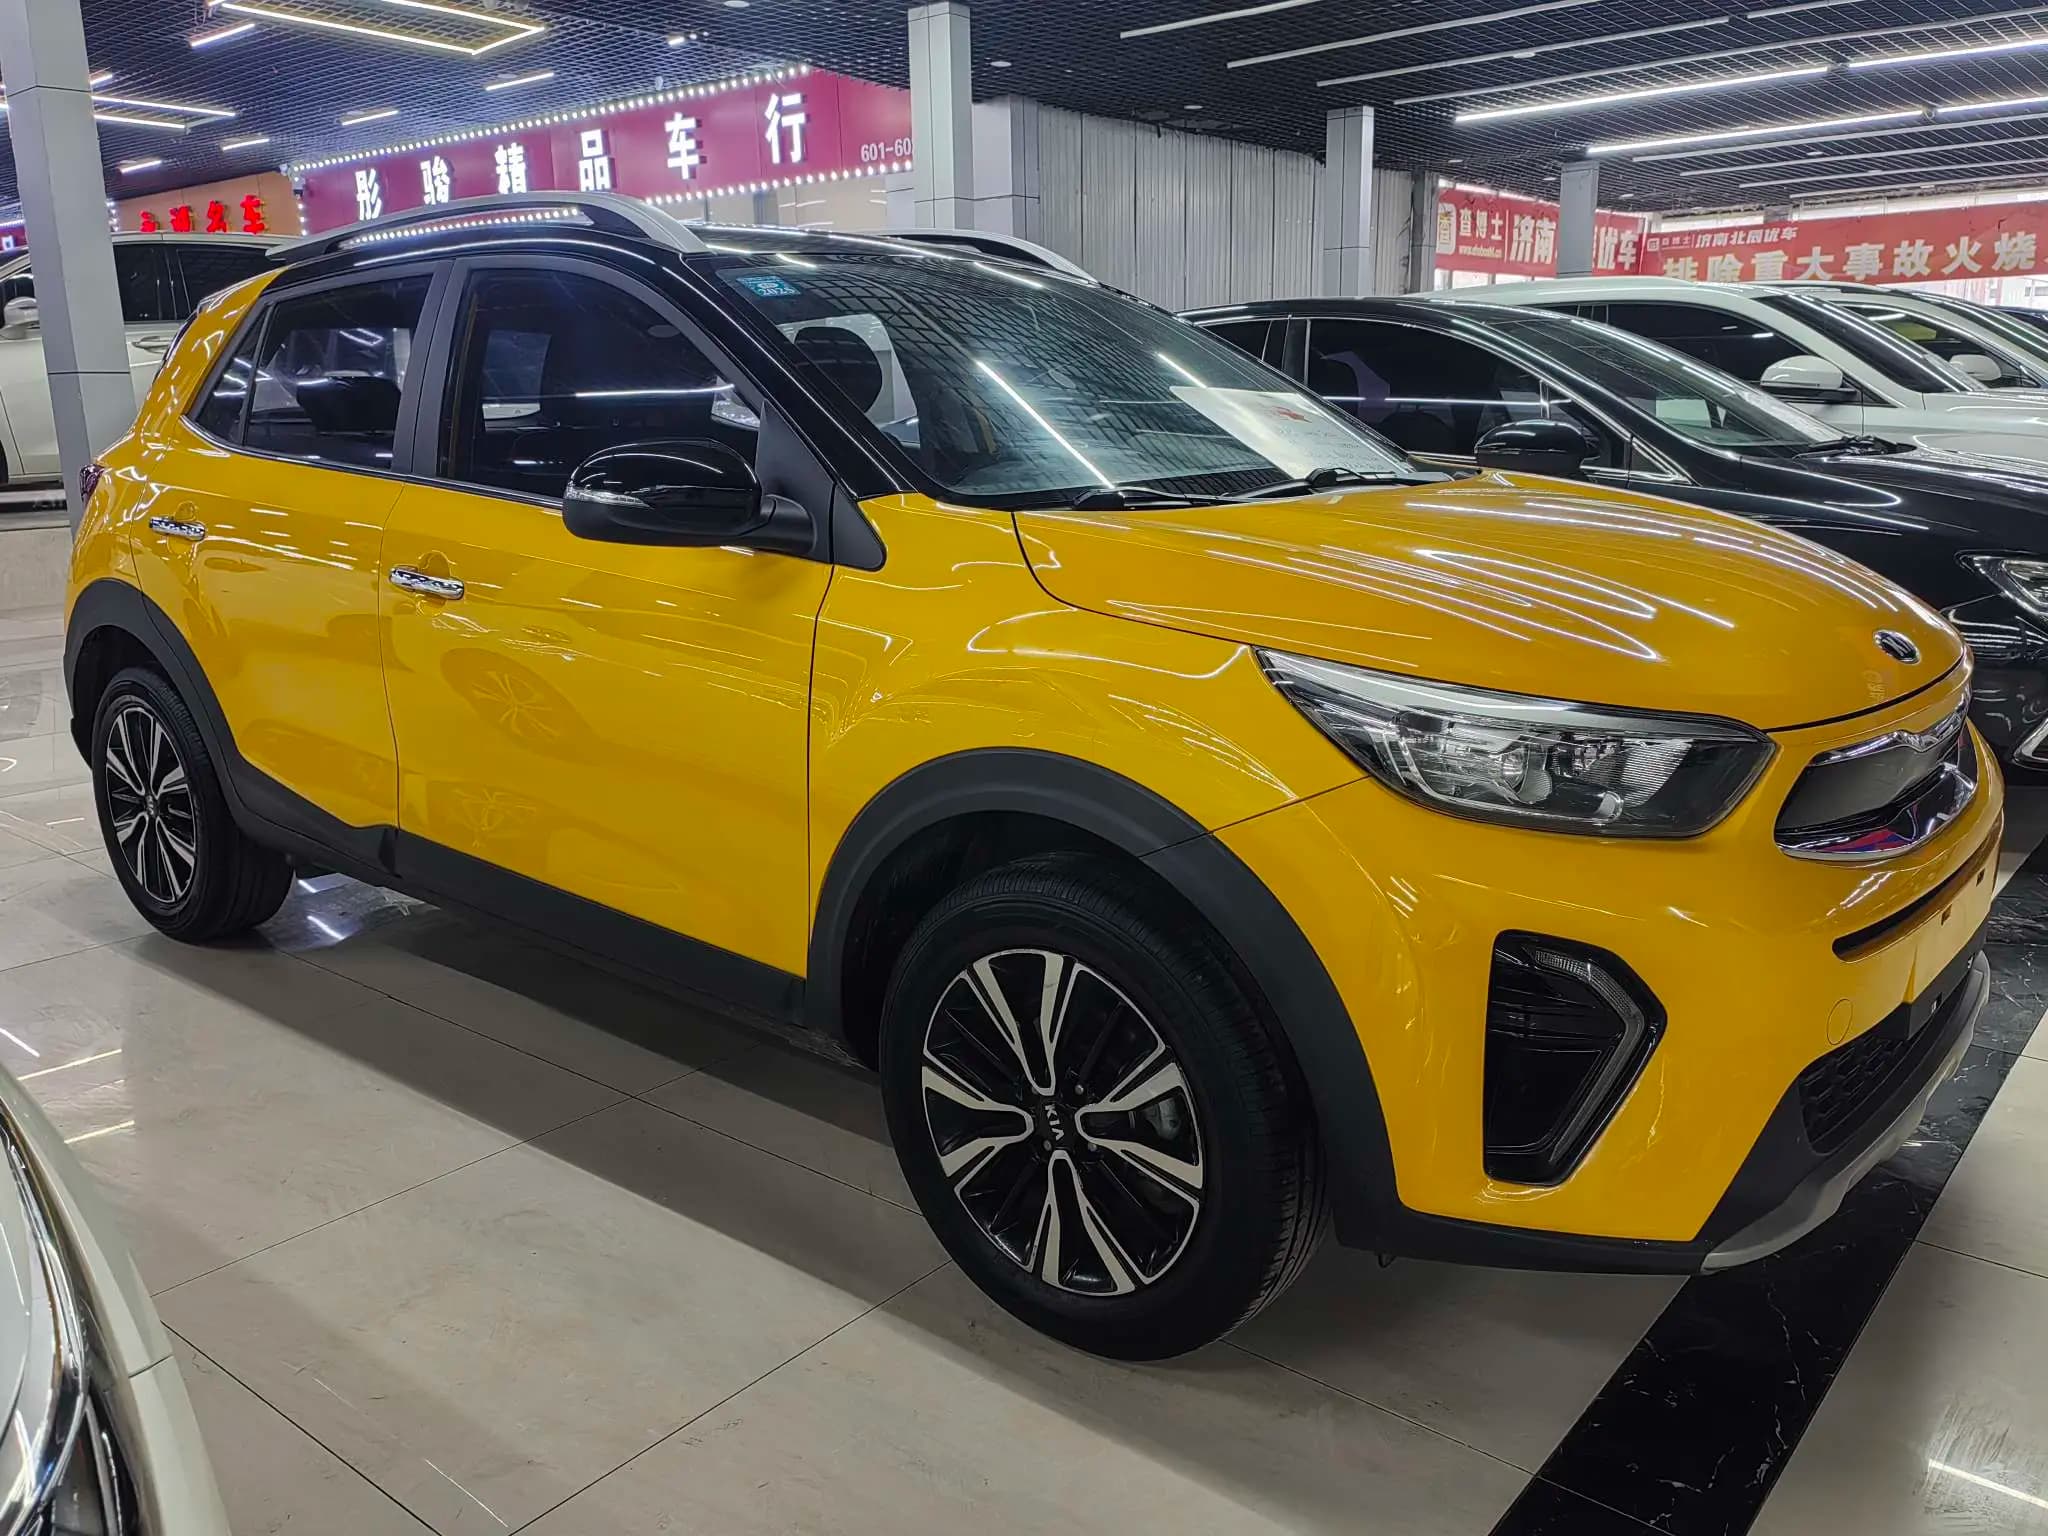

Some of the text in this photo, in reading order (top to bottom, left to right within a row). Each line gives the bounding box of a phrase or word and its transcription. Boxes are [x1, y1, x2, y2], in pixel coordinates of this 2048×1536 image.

[355, 93, 807, 221] 彤骏精品车行
[860, 137, 913, 162] 601-60
[1663, 230, 2048, 283] 排除重大事故火烧
[1044, 1104, 1064, 1140] KIA
